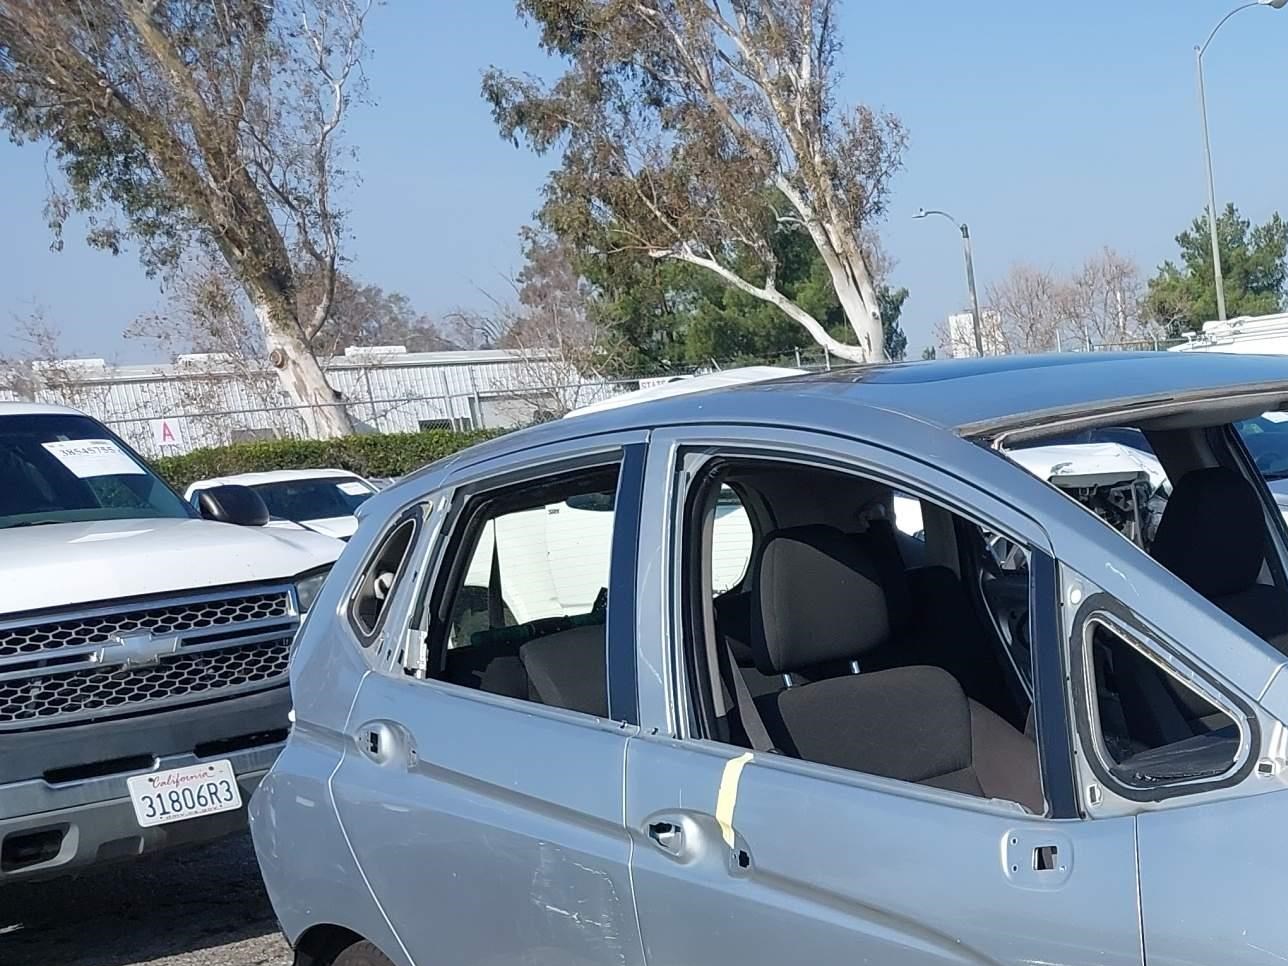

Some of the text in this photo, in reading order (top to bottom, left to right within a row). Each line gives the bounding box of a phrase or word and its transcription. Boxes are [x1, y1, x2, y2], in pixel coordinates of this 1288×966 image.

[162, 421, 176, 442] A
[152, 769, 214, 789] California
[141, 780, 234, 818] 31806R3
